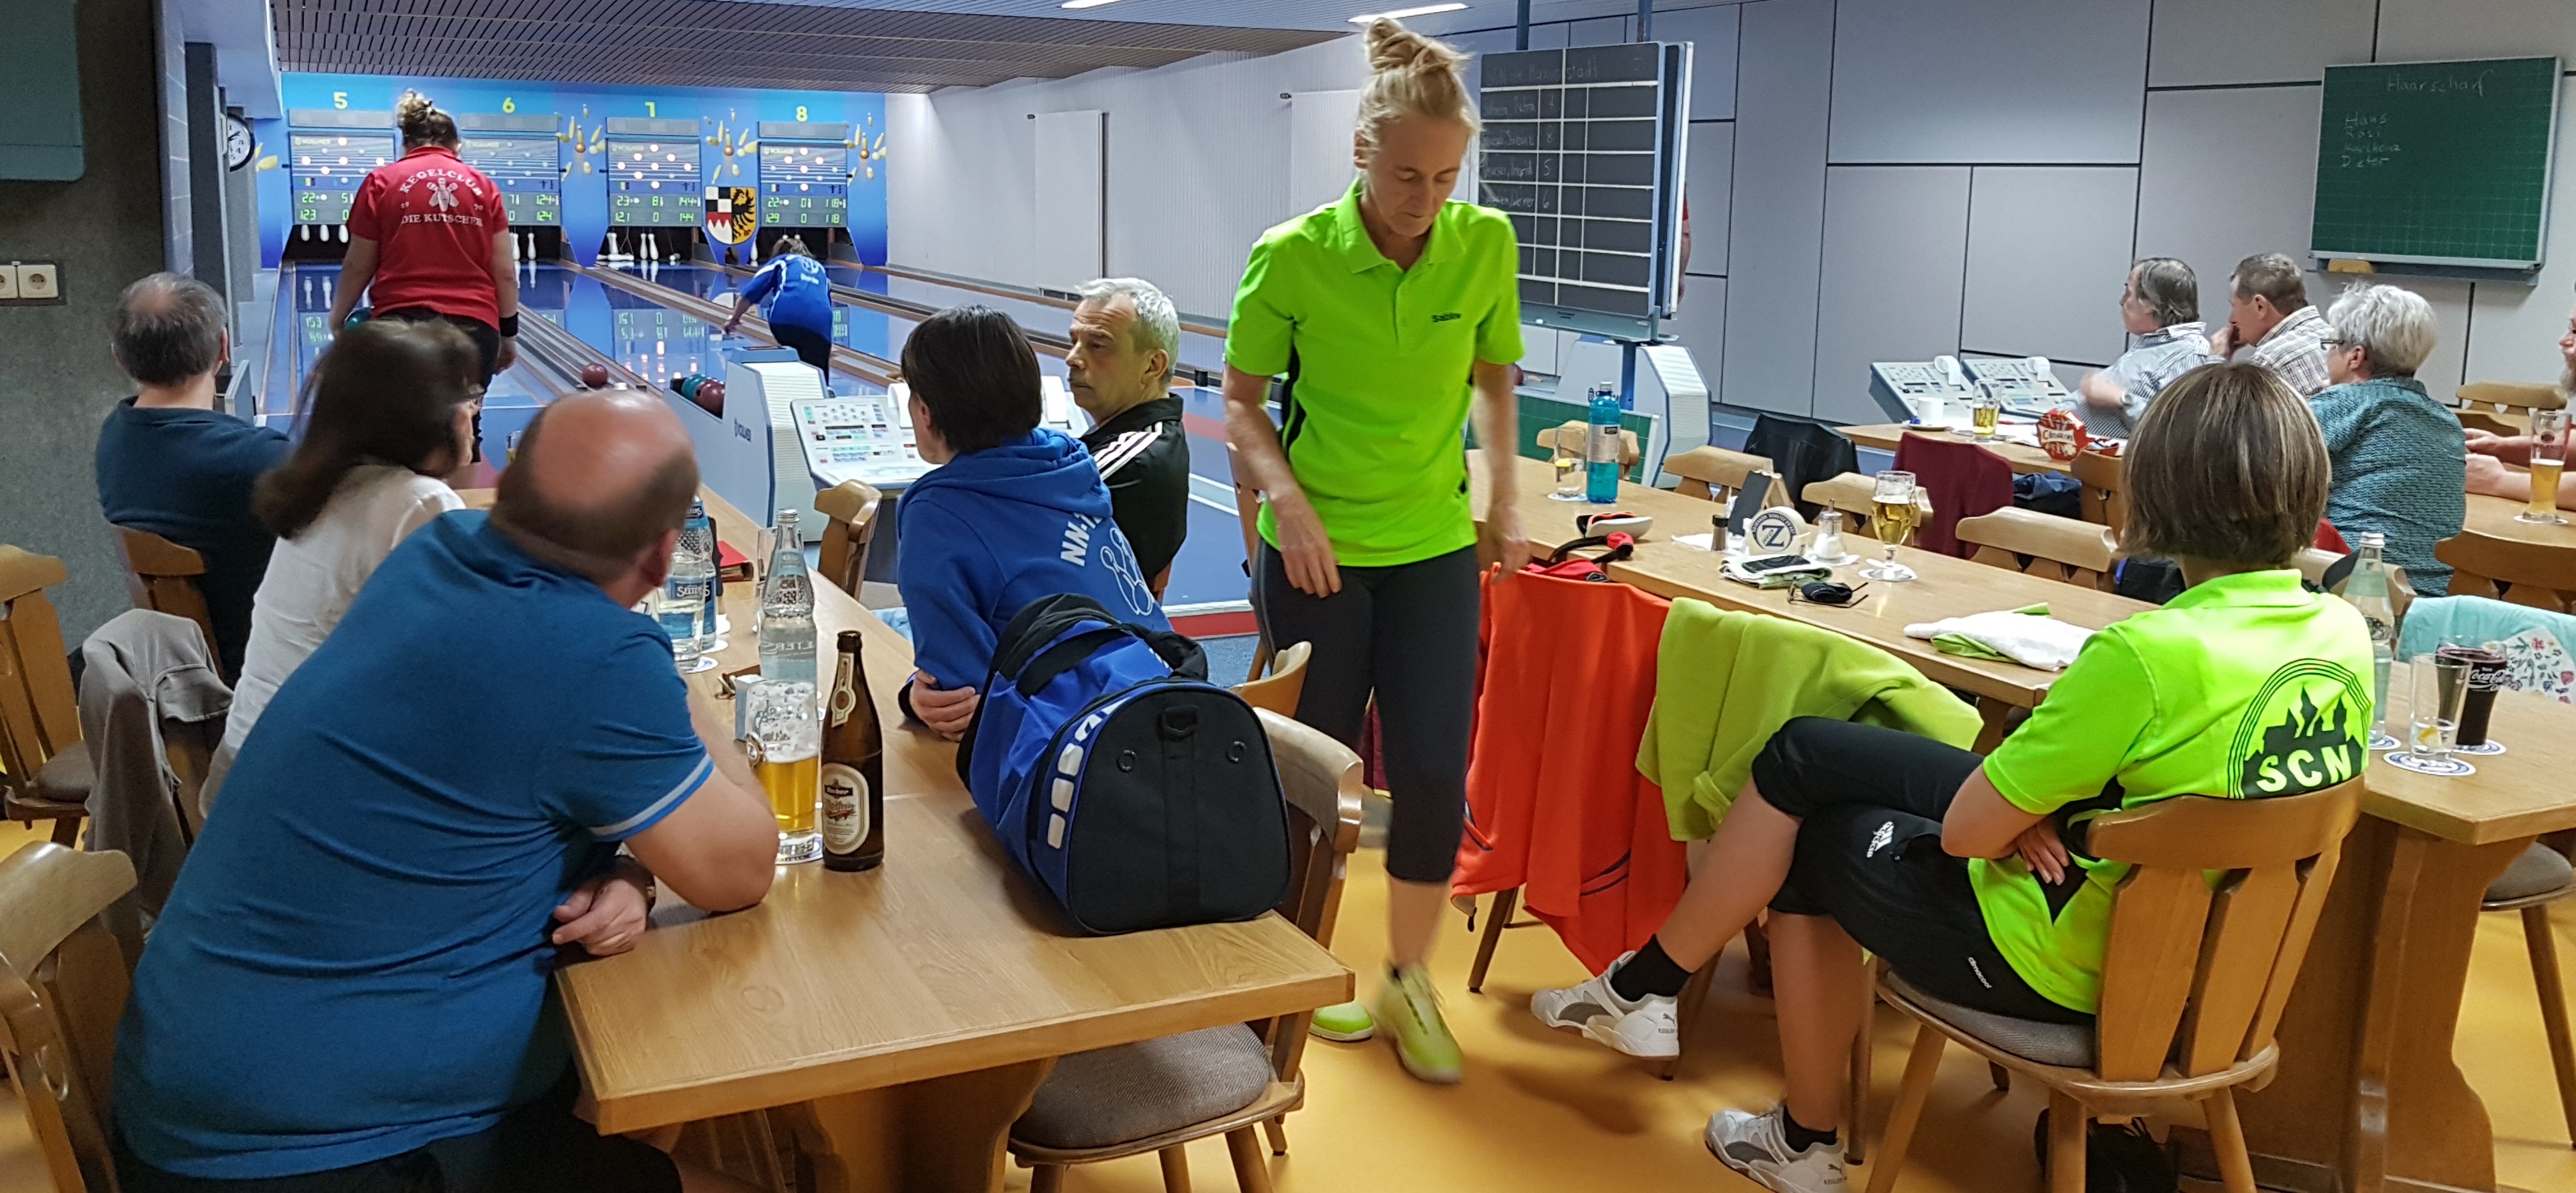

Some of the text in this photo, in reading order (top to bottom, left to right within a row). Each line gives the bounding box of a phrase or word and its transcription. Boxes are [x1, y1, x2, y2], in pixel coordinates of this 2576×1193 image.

[333, 92, 348, 109] 5
[502, 98, 515, 112] 6
[796, 106, 808, 121] 8
[1543, 158, 1551, 176] 5
[399, 168, 483, 196] KEGELCLUB
[302, 192, 316, 203] 22
[617, 196, 630, 206] 23
[1543, 190, 1550, 209] 6
[300, 209, 316, 220] 123
[402, 213, 483, 227] DIE KUTSCHER
[615, 212, 631, 222] 121
[653, 212, 659, 222] 0
[801, 213, 808, 224] 0
[2256, 743, 2353, 792] SCN
[1968, 957, 1993, 989] climacool
